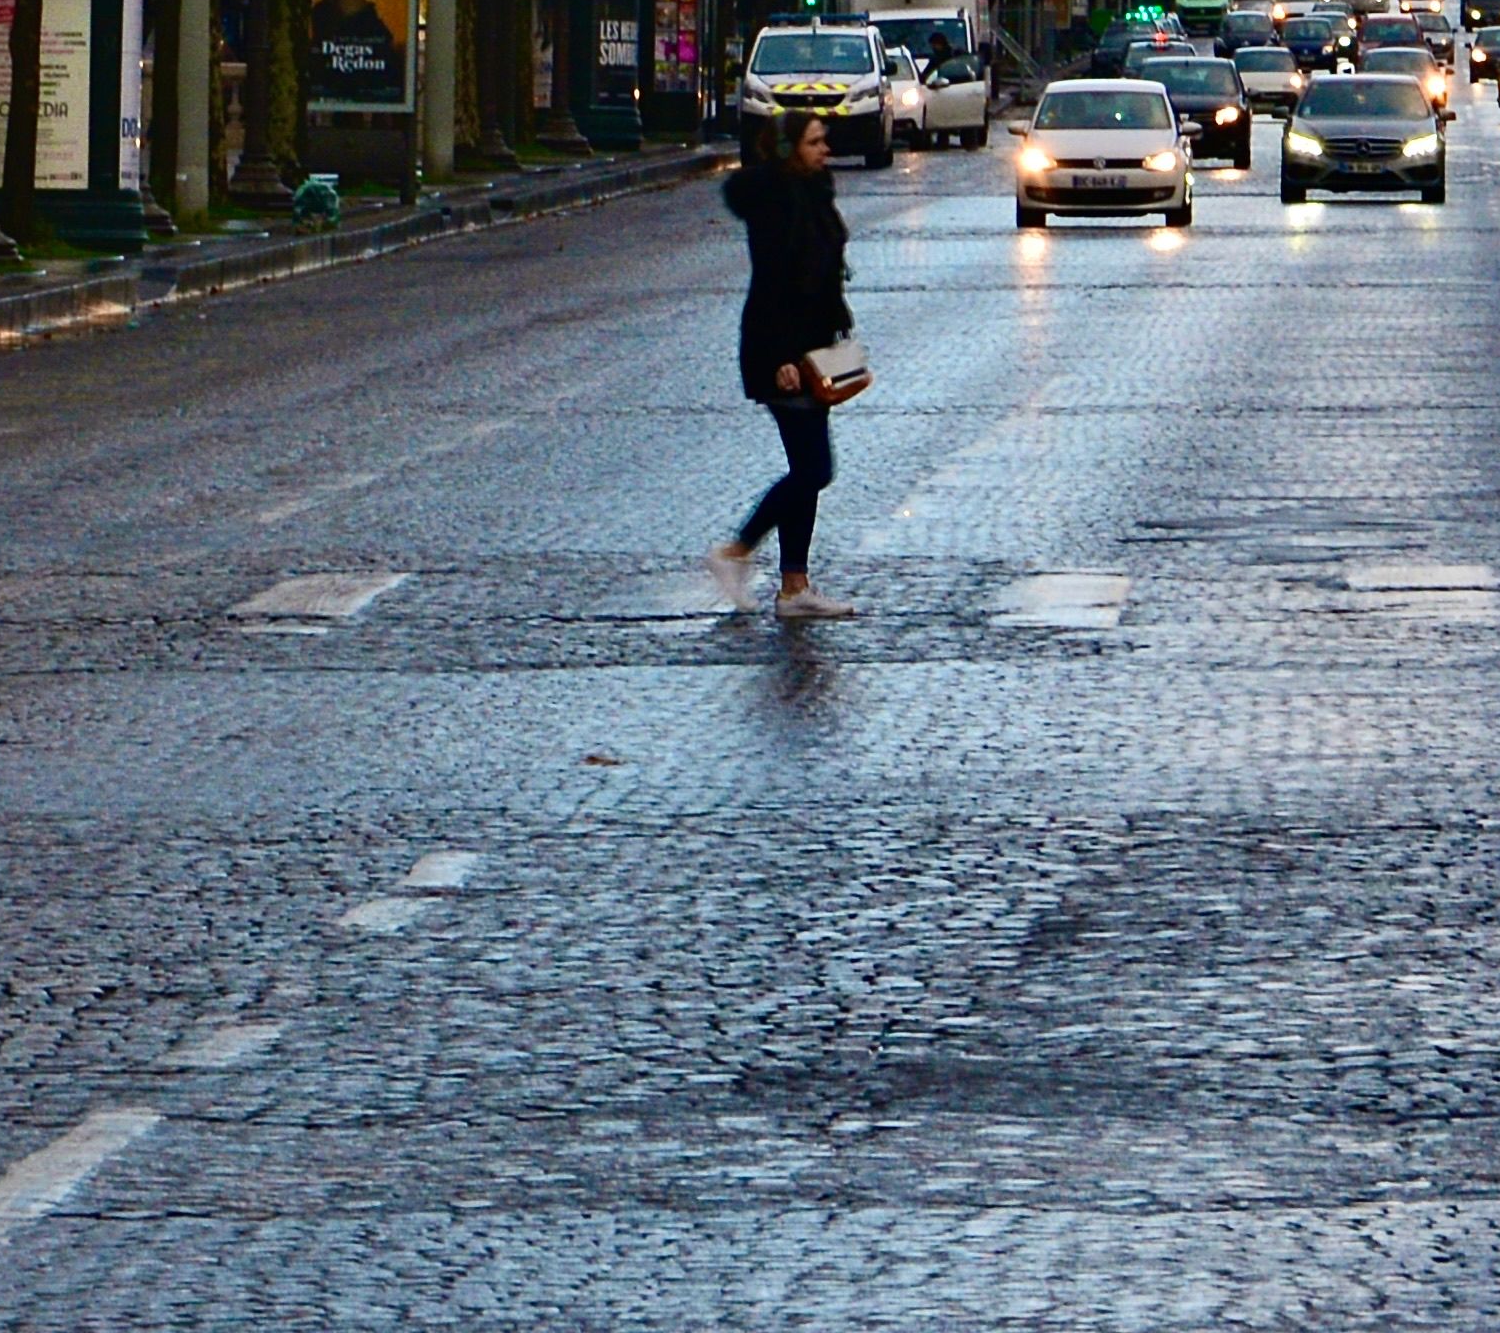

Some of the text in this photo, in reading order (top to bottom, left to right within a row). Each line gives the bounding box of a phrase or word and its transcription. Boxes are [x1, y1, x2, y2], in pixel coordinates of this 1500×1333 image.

[601, 20, 620, 41] LES
[322, 41, 374, 58] Degas
[332, 54, 387, 74] Redon
